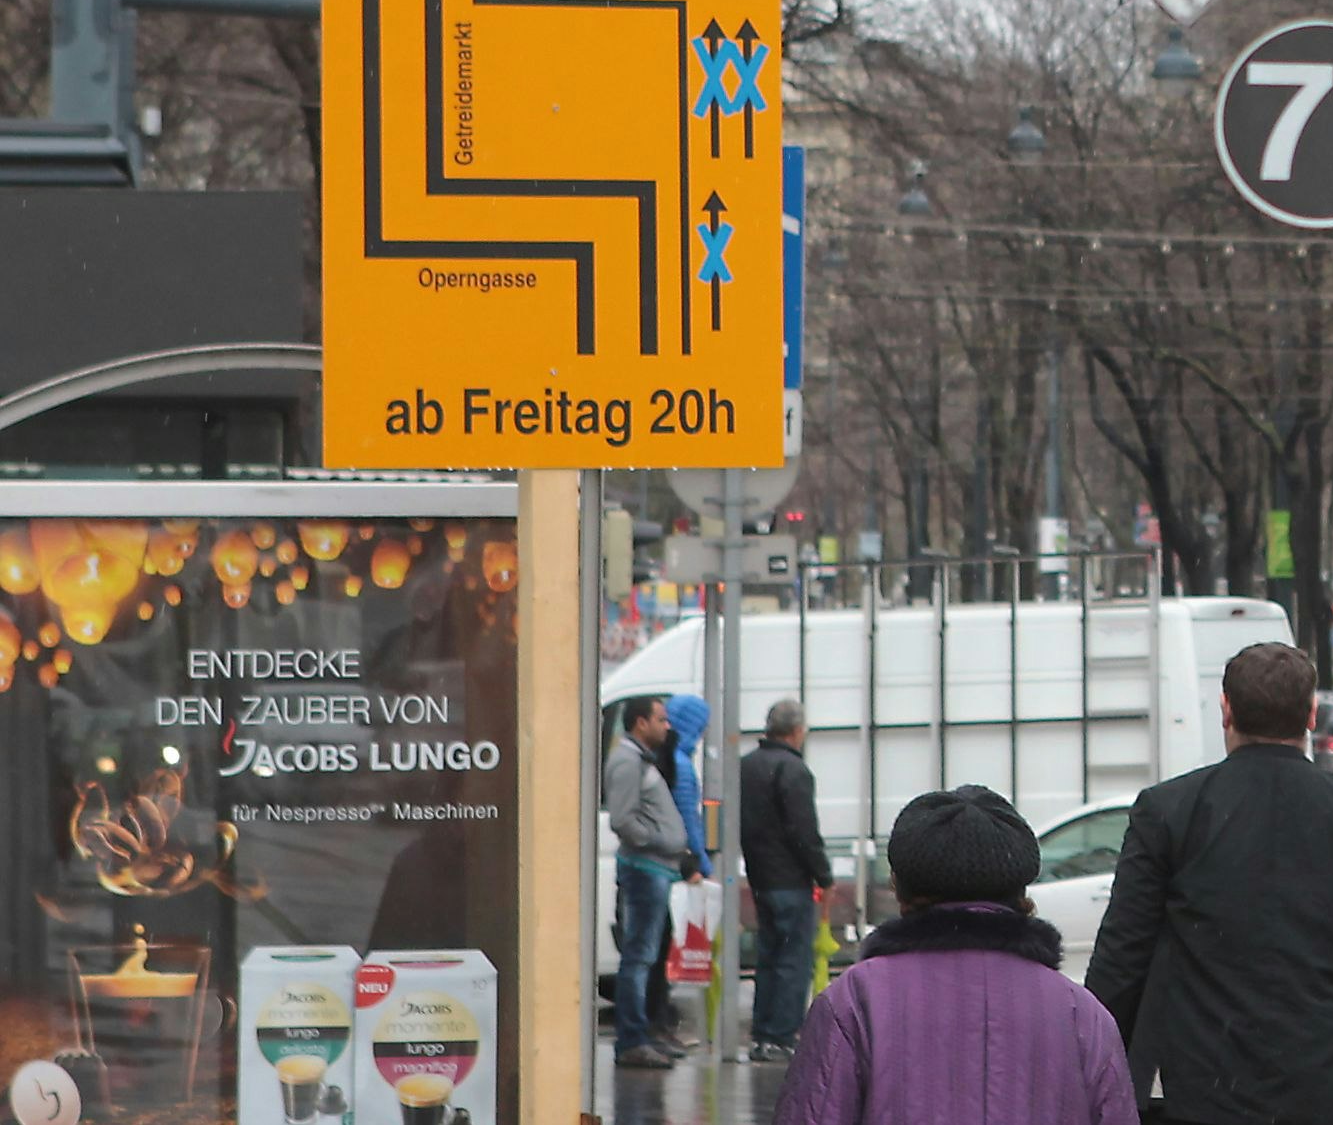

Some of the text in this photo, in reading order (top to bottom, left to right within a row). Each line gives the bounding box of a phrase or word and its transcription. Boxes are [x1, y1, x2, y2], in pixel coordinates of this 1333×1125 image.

[454, 21, 474, 166] Getreidemarkt
[418, 267, 537, 293] Operngasse
[385, 388, 444, 435] ab
[463, 388, 632, 447] Freitag
[649, 388, 736, 434] 20h
[188, 649, 361, 680] ENTDECKE
[156, 695, 449, 726] DEN ZAUBER VON
[219, 739, 500, 776] JACOBS LUNGO
[232, 803, 259, 823] für
[393, 802, 499, 820] Maschinen
[359, 982, 388, 994] NEU
[401, 1001, 453, 1017] JACOBS
[286, 1028, 320, 1040] lungo
[407, 1042, 446, 1057] lungo
